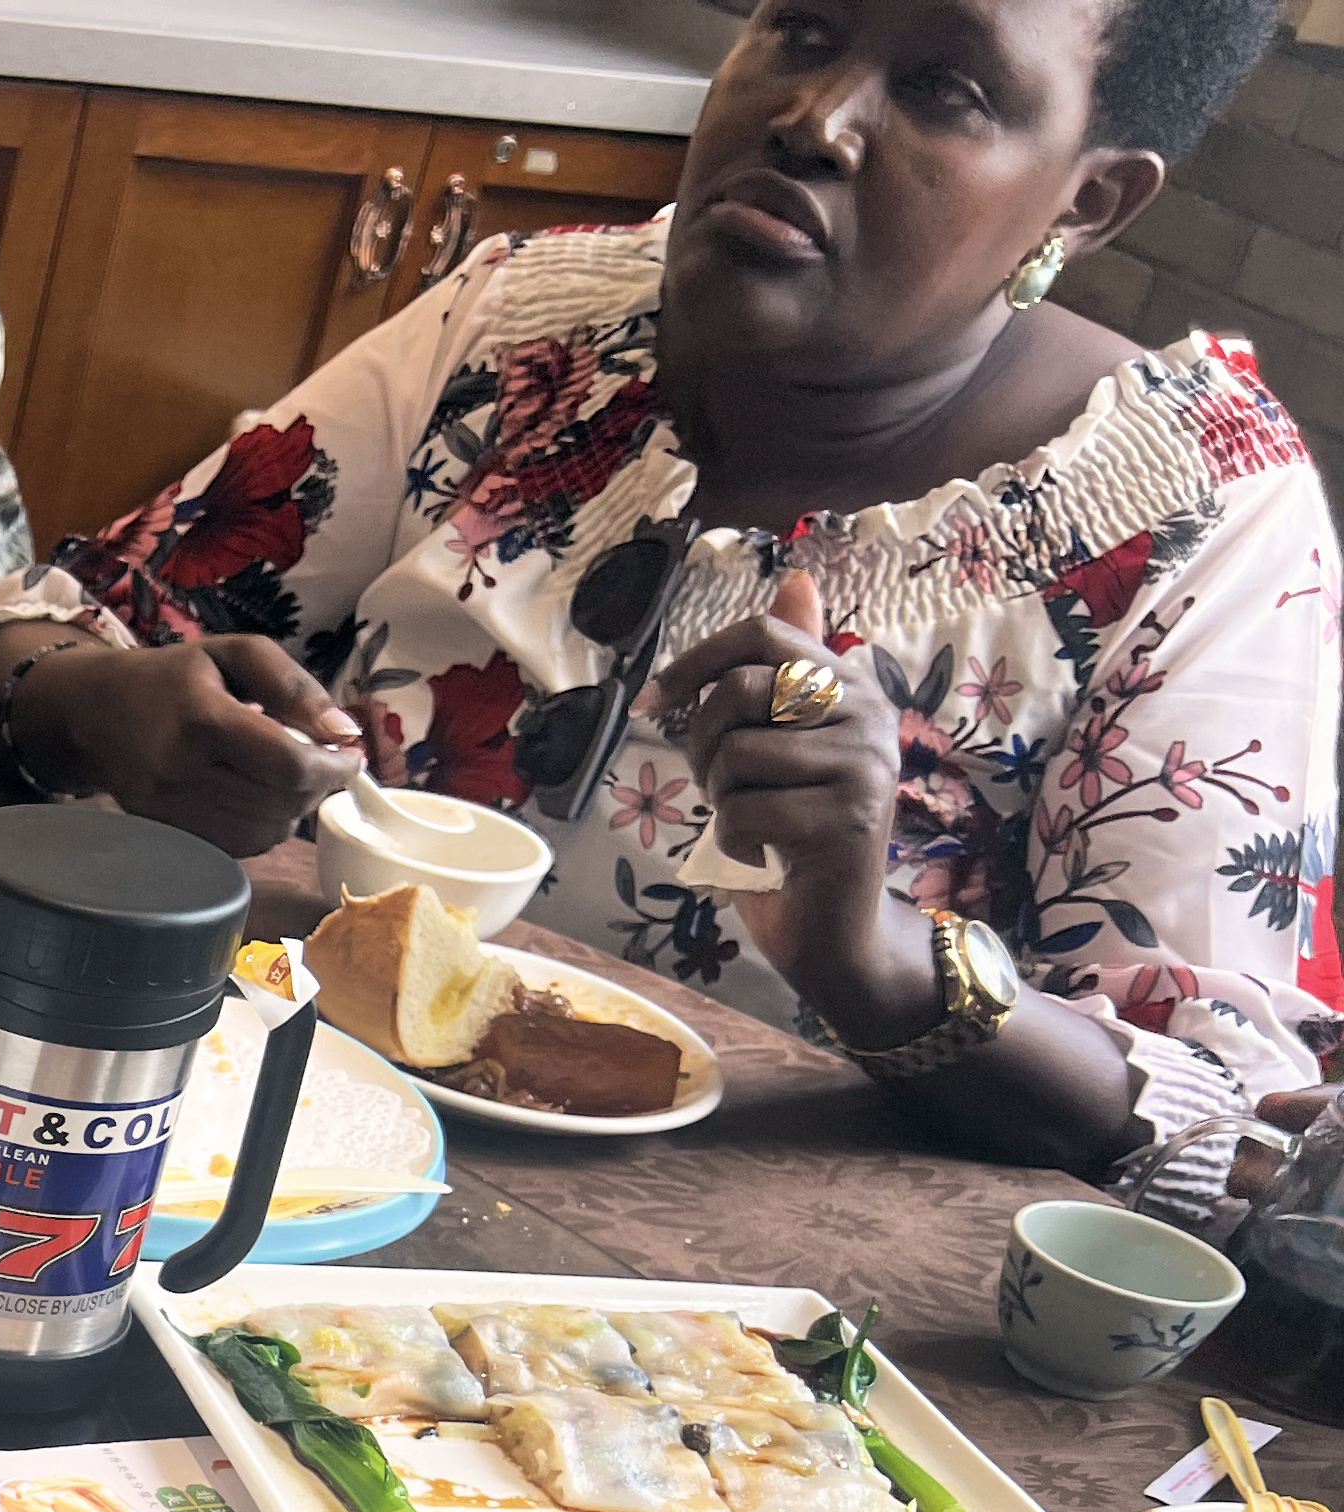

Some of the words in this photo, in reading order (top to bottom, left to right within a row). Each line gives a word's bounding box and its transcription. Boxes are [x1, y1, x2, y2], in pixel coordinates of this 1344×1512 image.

[33, 1112, 70, 1146] &
[50, 1299, 72, 1315] BY
[72, 1292, 107, 1313] JUST
